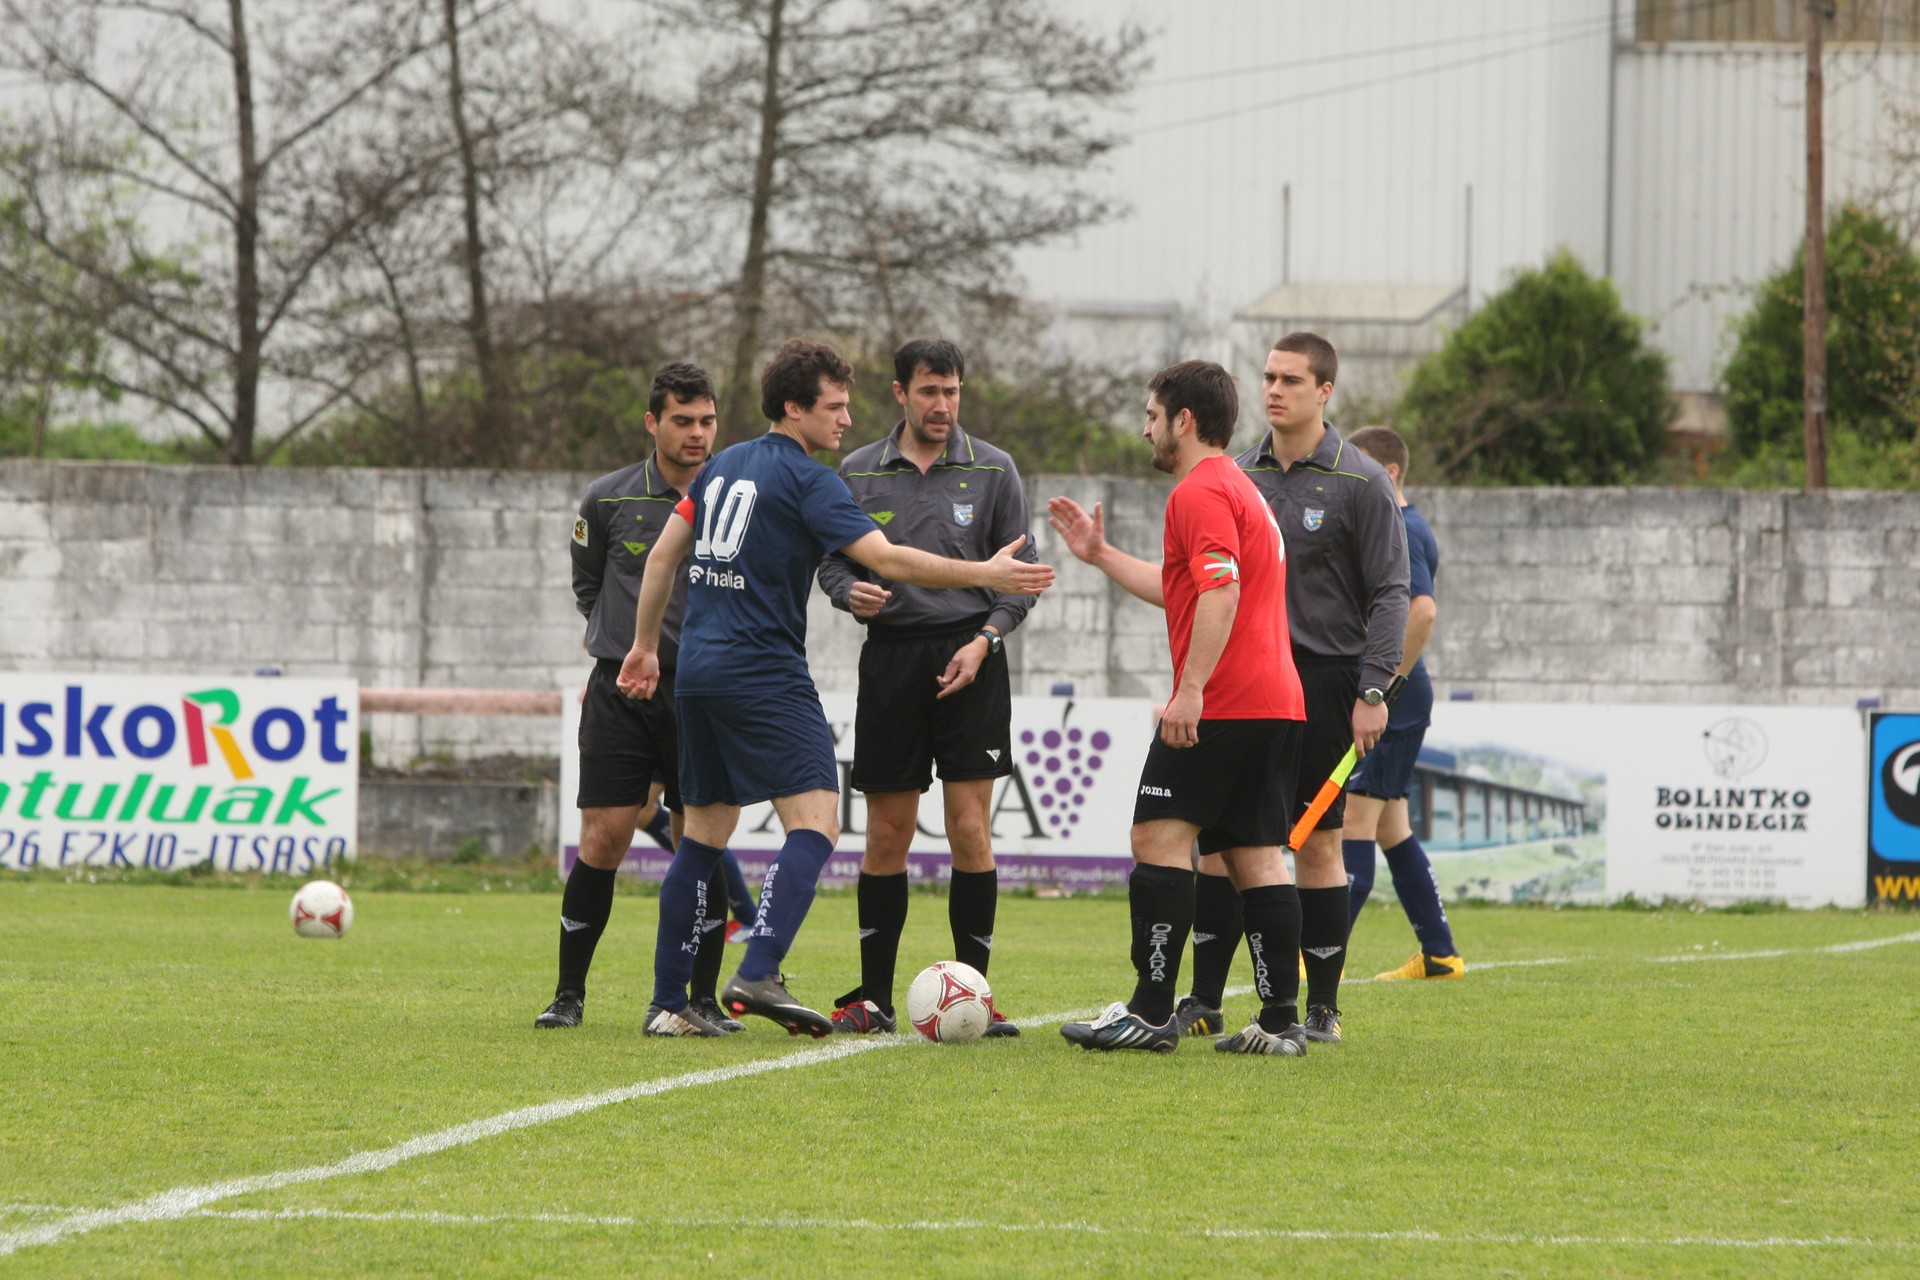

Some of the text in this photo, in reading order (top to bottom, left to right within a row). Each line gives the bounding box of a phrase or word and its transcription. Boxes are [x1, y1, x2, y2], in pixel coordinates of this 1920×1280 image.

[694, 476, 758, 563] 10
[0, 685, 348, 781] skoRot
[692, 879, 708, 944] BERGARA
[755, 863, 779, 927] BERGARA
[1249, 932, 1274, 998] OSTADAR
